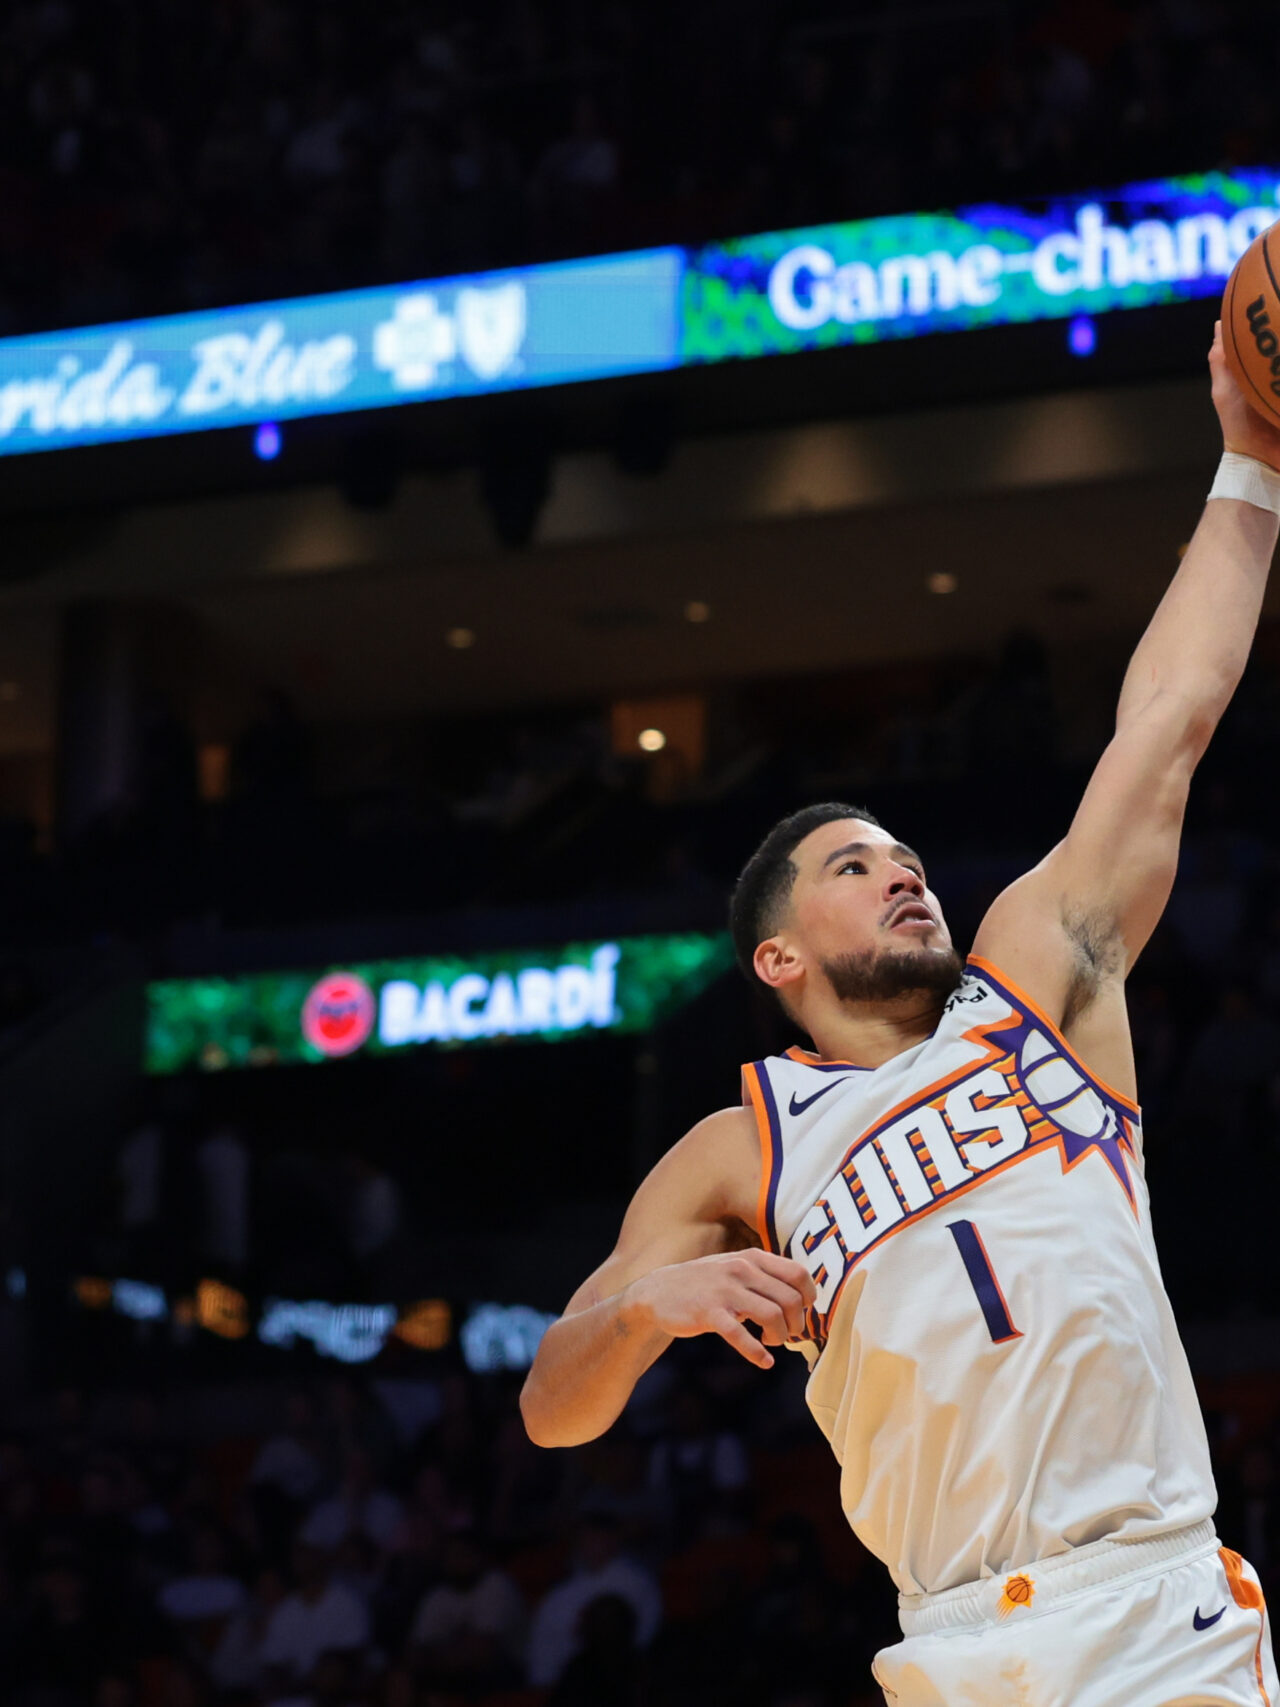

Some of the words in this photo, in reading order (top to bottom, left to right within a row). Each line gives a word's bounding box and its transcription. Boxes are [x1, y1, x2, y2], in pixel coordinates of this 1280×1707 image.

[177, 320, 355, 412] Blue
[380, 944, 620, 1047] BACARDÍ
[945, 1219, 1024, 1344] 1
